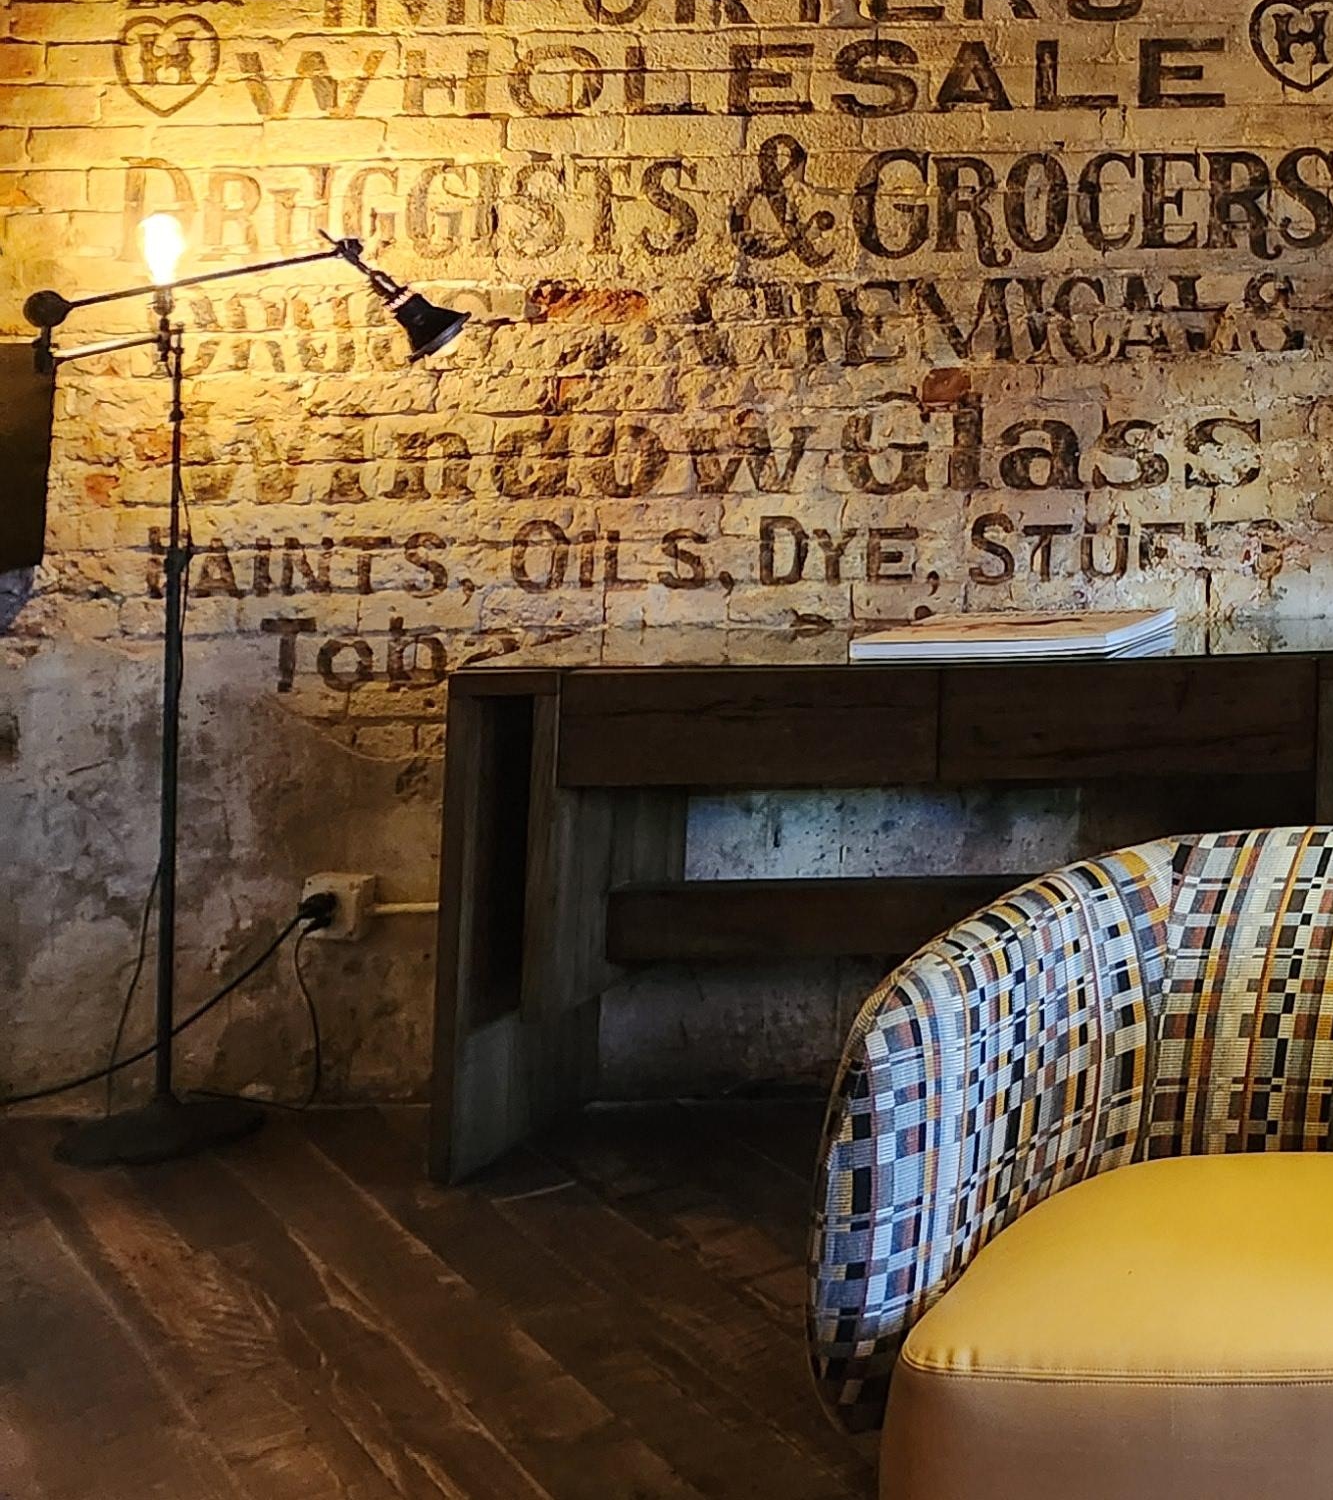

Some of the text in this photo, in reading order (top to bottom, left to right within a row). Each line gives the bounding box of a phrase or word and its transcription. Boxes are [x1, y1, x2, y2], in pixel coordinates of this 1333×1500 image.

[236, 40, 1226, 118] WHOLESALE
[1271, 10, 1330, 65] H
[728, 133, 836, 268] &
[841, 392, 1261, 494] Glass
